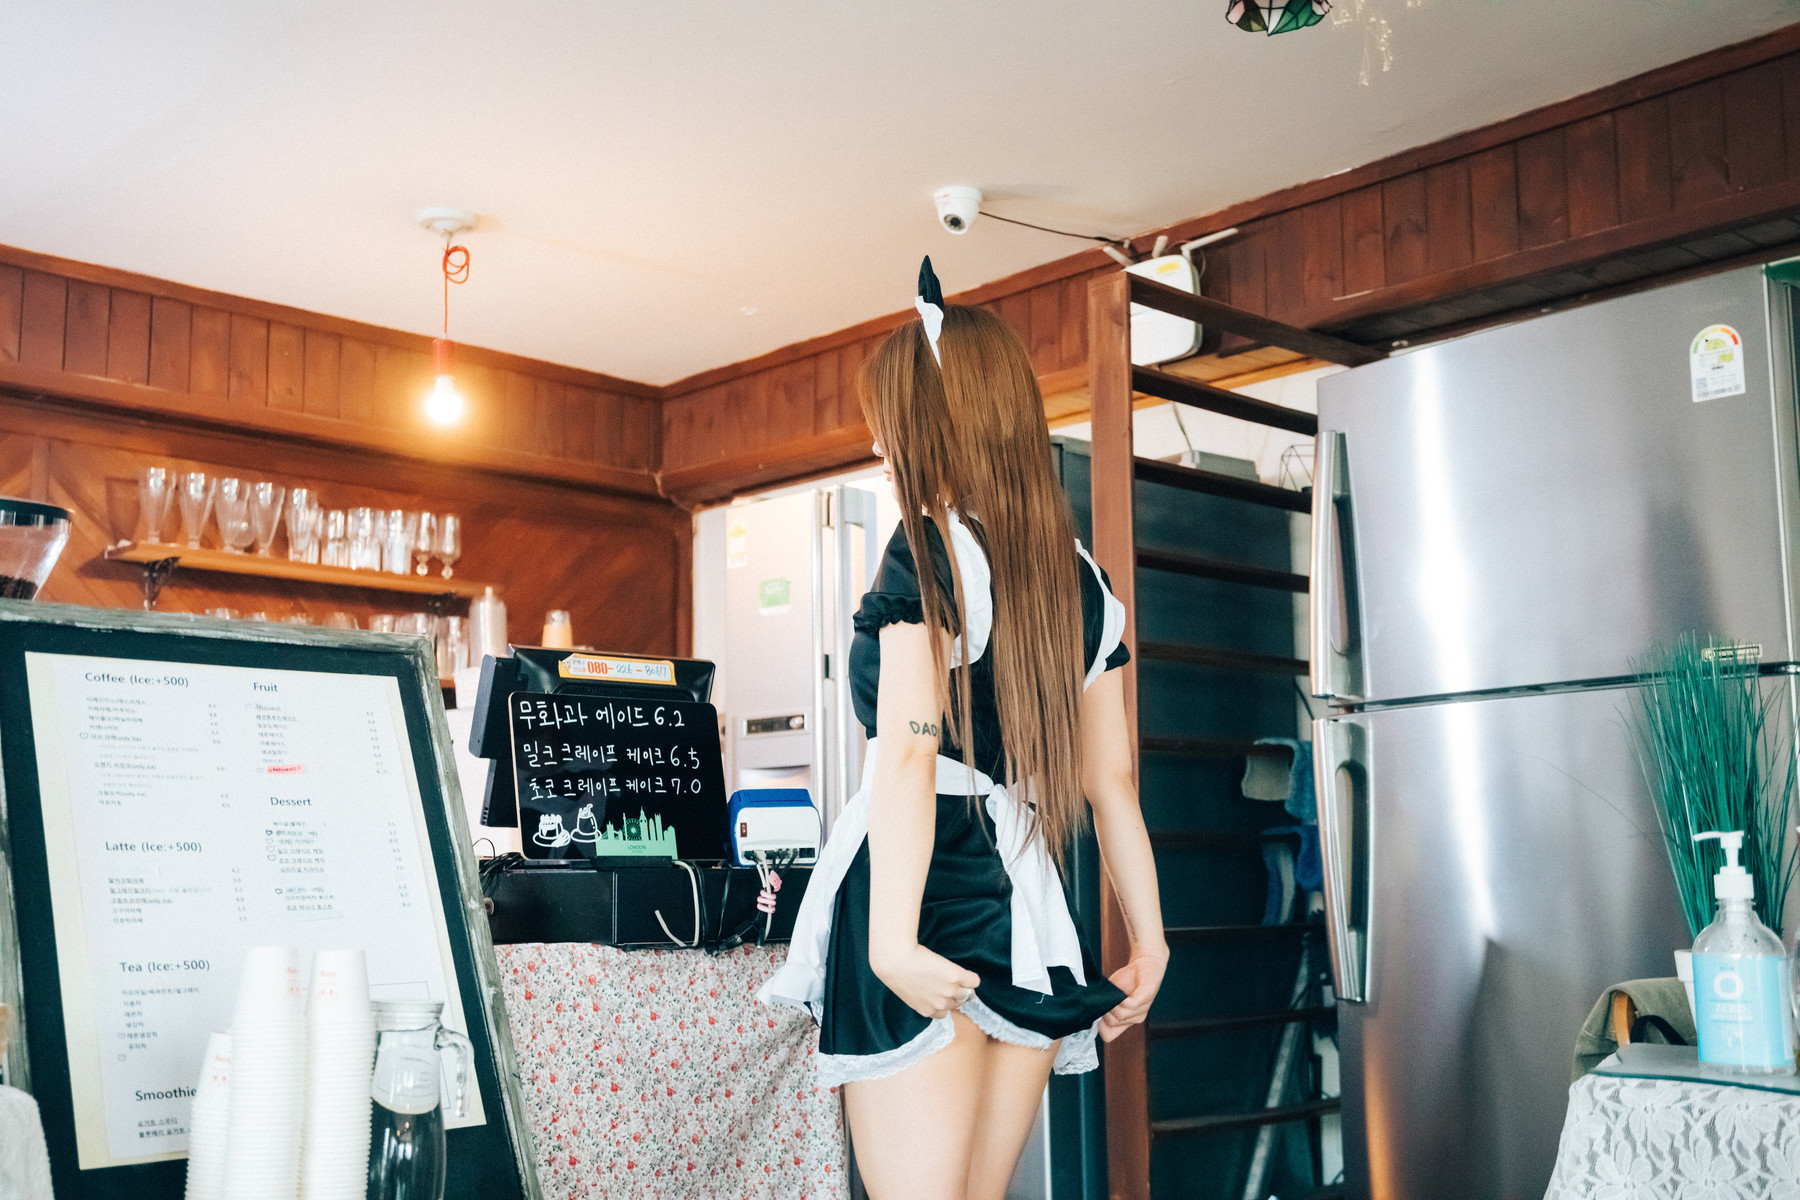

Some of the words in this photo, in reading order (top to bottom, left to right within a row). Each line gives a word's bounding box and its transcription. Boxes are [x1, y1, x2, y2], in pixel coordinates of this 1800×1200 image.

[85, 672, 125, 684] Coffee
[130, 674, 189, 688] (Ice:+500)
[253, 682, 278, 693] Fruit
[519, 701, 587, 729] 무화과
[595, 703, 648, 729] 에이드
[653, 707, 684, 726] 6.2
[909, 720, 938, 737] DAD
[523, 741, 557, 767] 밀크
[561, 744, 617, 763] 크레이프
[626, 748, 664, 765] 케이크
[670, 746, 699, 769] 6.5
[528, 778, 557, 800] 초코
[563, 778, 620, 796] 크레이프
[625, 777, 666, 792] 케이크
[671, 778, 701, 794] 7.0
[270, 796, 312, 807] Dessert
[105, 841, 136, 852] Latte
[141, 841, 202, 853] (Ice:+500)
[120, 962, 142, 972] Tea
[148, 960, 210, 973] (Ice:+500)
